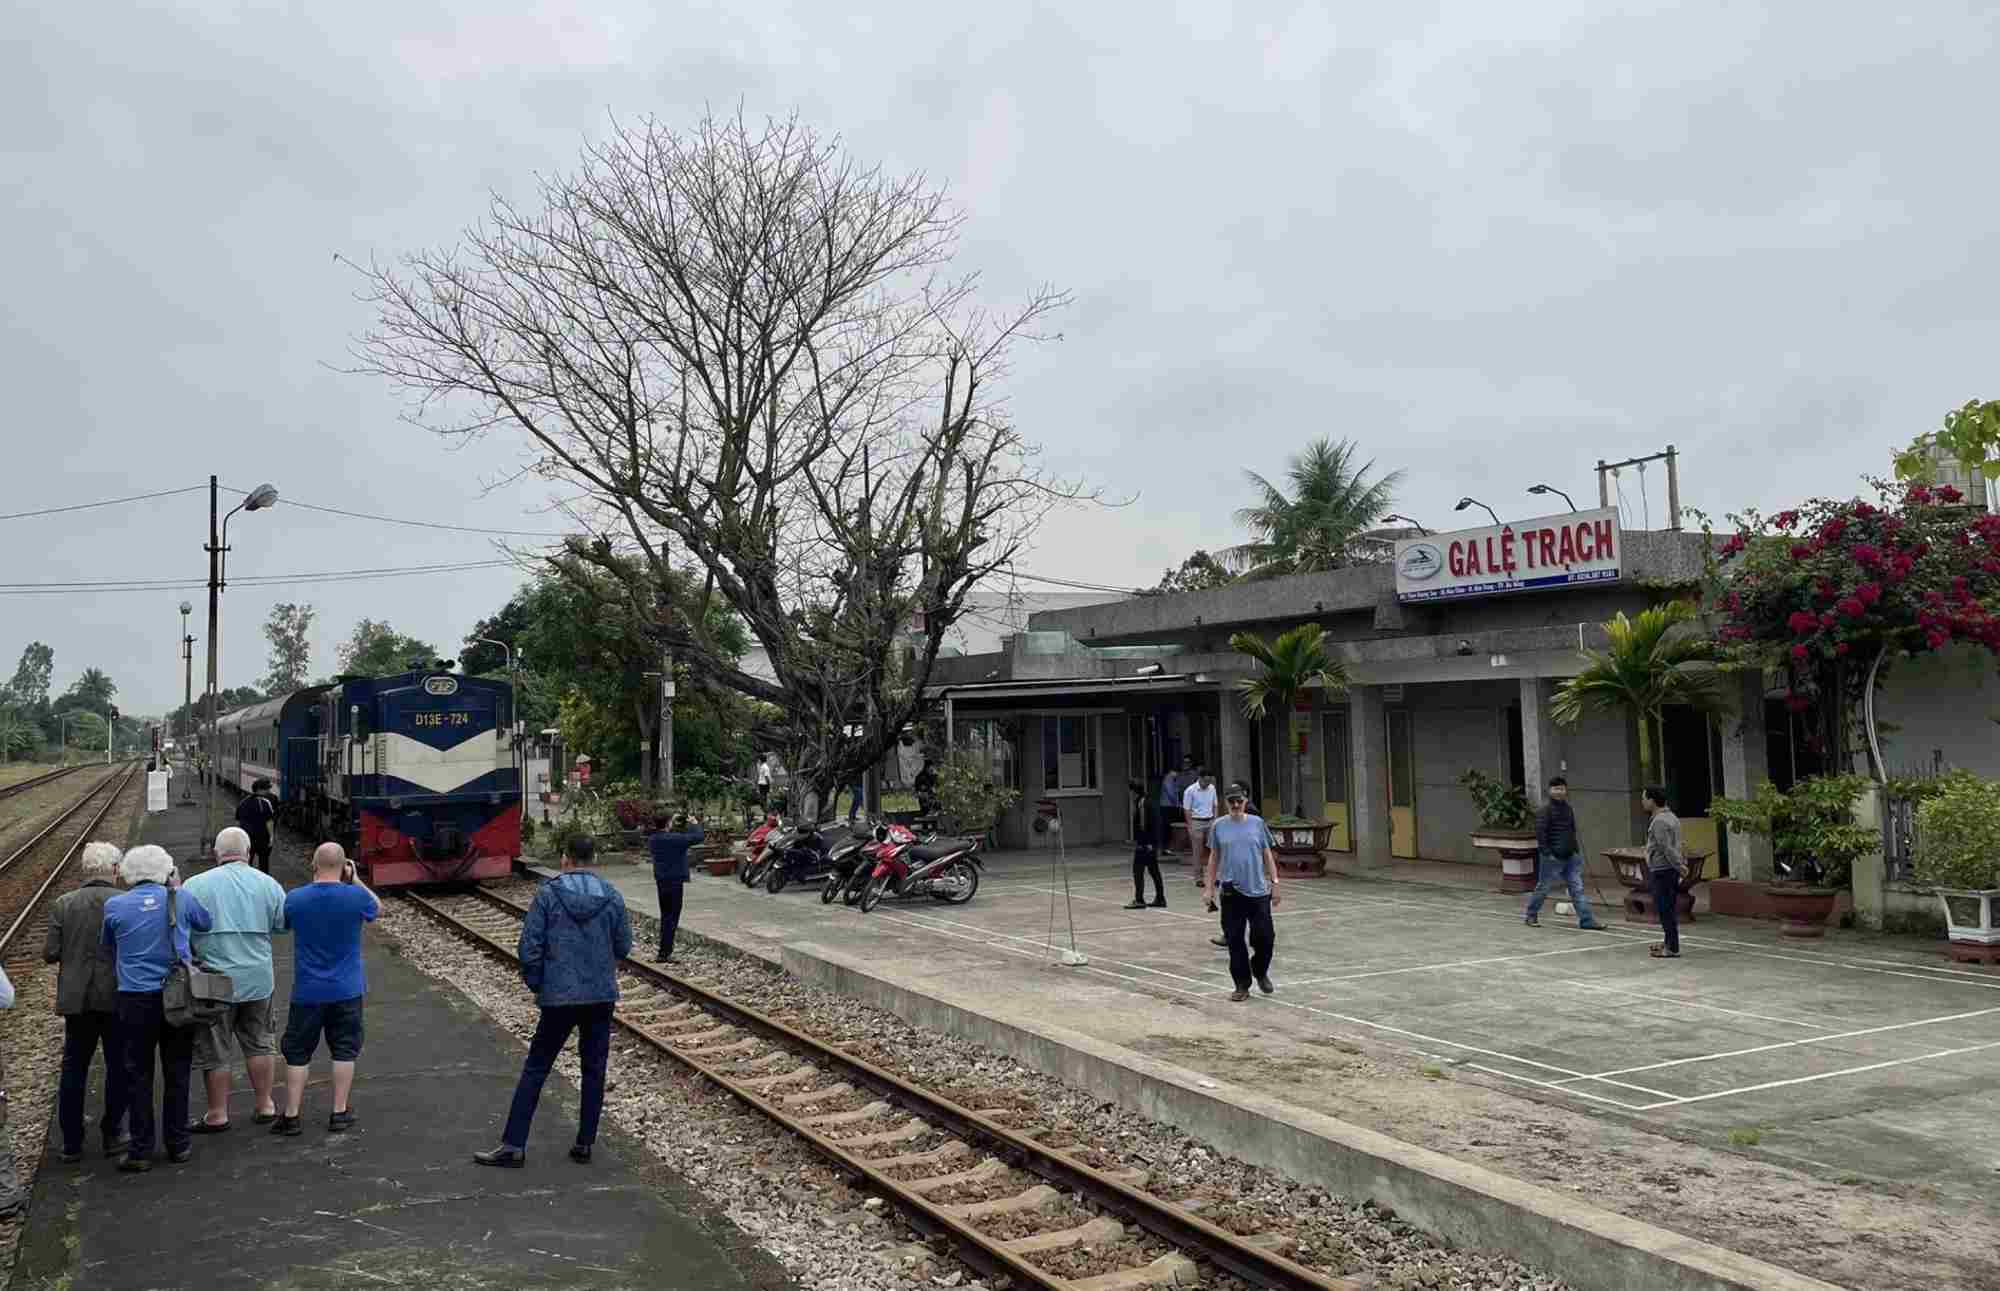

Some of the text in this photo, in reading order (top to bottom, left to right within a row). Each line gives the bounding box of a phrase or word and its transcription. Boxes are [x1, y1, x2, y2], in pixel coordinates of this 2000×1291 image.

[1449, 519, 1614, 578] GA LỆ TRẠCH
